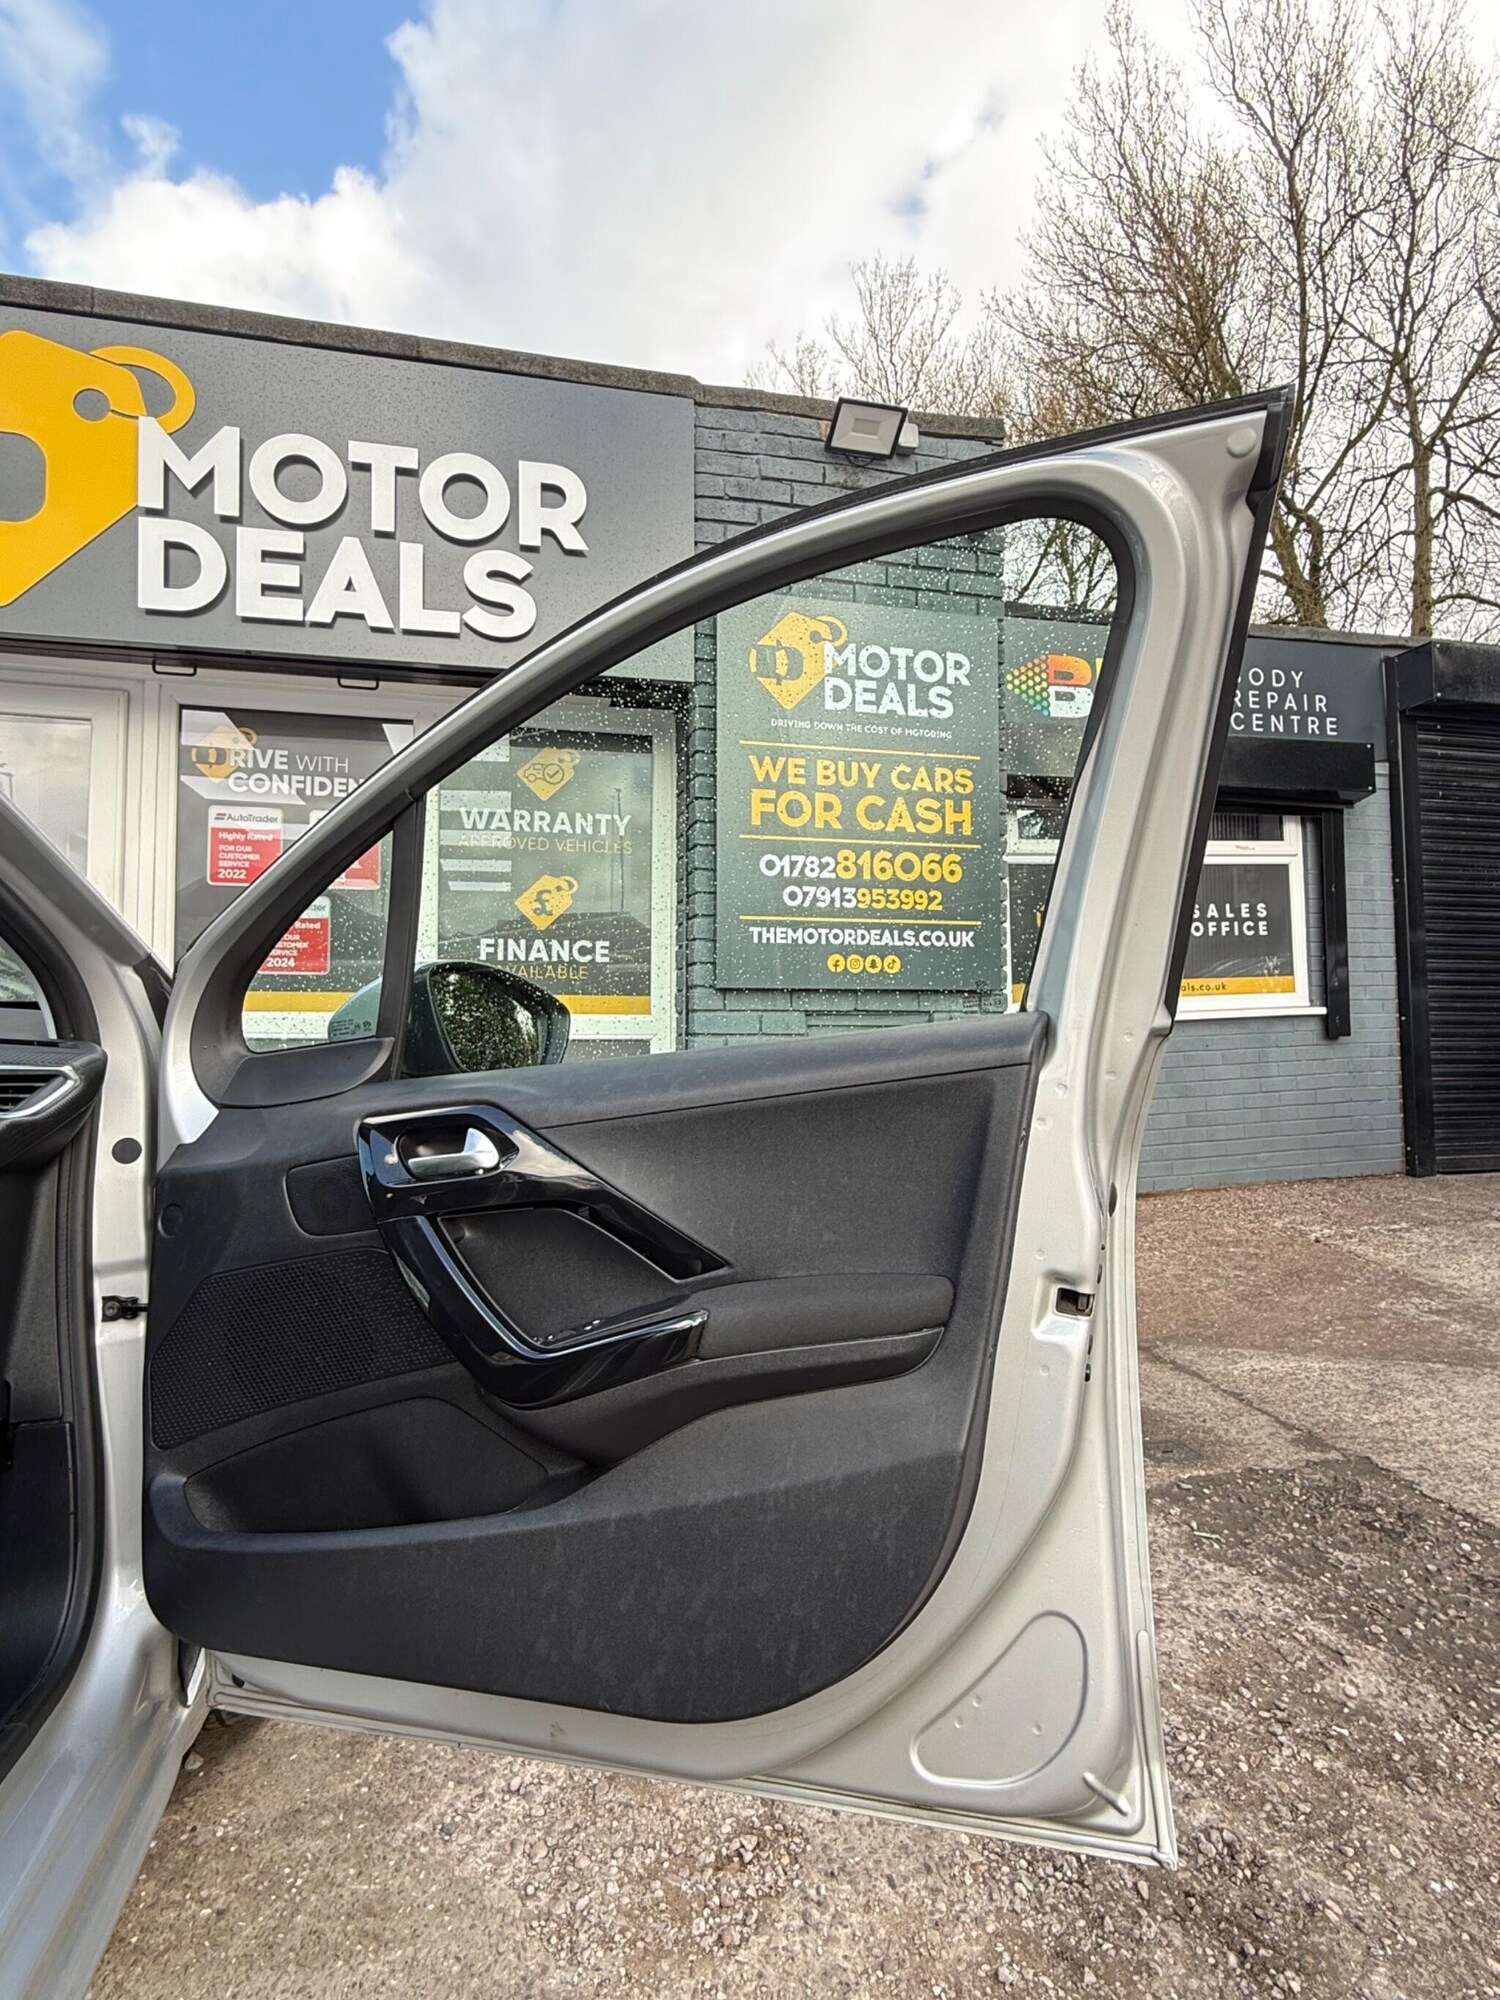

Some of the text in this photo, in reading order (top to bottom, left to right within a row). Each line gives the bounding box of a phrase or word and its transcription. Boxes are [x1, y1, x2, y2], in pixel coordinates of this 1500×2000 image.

[137, 415, 590, 553] MOTOR
[137, 515, 539, 639] DEALS
[824, 640, 971, 686] MOTOR
[1238, 667, 1304, 689] ODY
[823, 676, 955, 719] DEALS
[1234, 689, 1328, 713] REPAIR
[770, 718, 953, 740] DRIVING DOWN THE COST OF MOTORING
[1230, 711, 1339, 736] CENTRE
[296, 754, 349, 773] WITH
[748, 755, 975, 794] WE BUY CARS
[226, 813, 279, 824] AutoTrader
[458, 806, 633, 837] WARRANTY
[750, 788, 972, 836] FOR CASH
[218, 831, 273, 842] Highly Rated
[457, 834, 633, 855] APPROVED VEHICLES
[218, 844, 235, 852] FOR
[218, 852, 260, 861] CUSTOMER
[217, 868, 247, 879] 2022
[218, 860, 250, 868] SERVICE
[759, 849, 963, 884] 01782816066
[782, 885, 943, 911] 07913953992
[1192, 903, 1268, 919] SALES
[295, 921, 321, 929] Rated
[1190, 921, 1269, 937] OFFICE
[275, 941, 309, 949] STOMER
[749, 926, 975, 948] THEMOTORDEALS.CO.UK
[478, 938, 611, 963] FINANCE
[266, 957, 296, 968] 2024
[497, 964, 588, 980] VAILABLE
